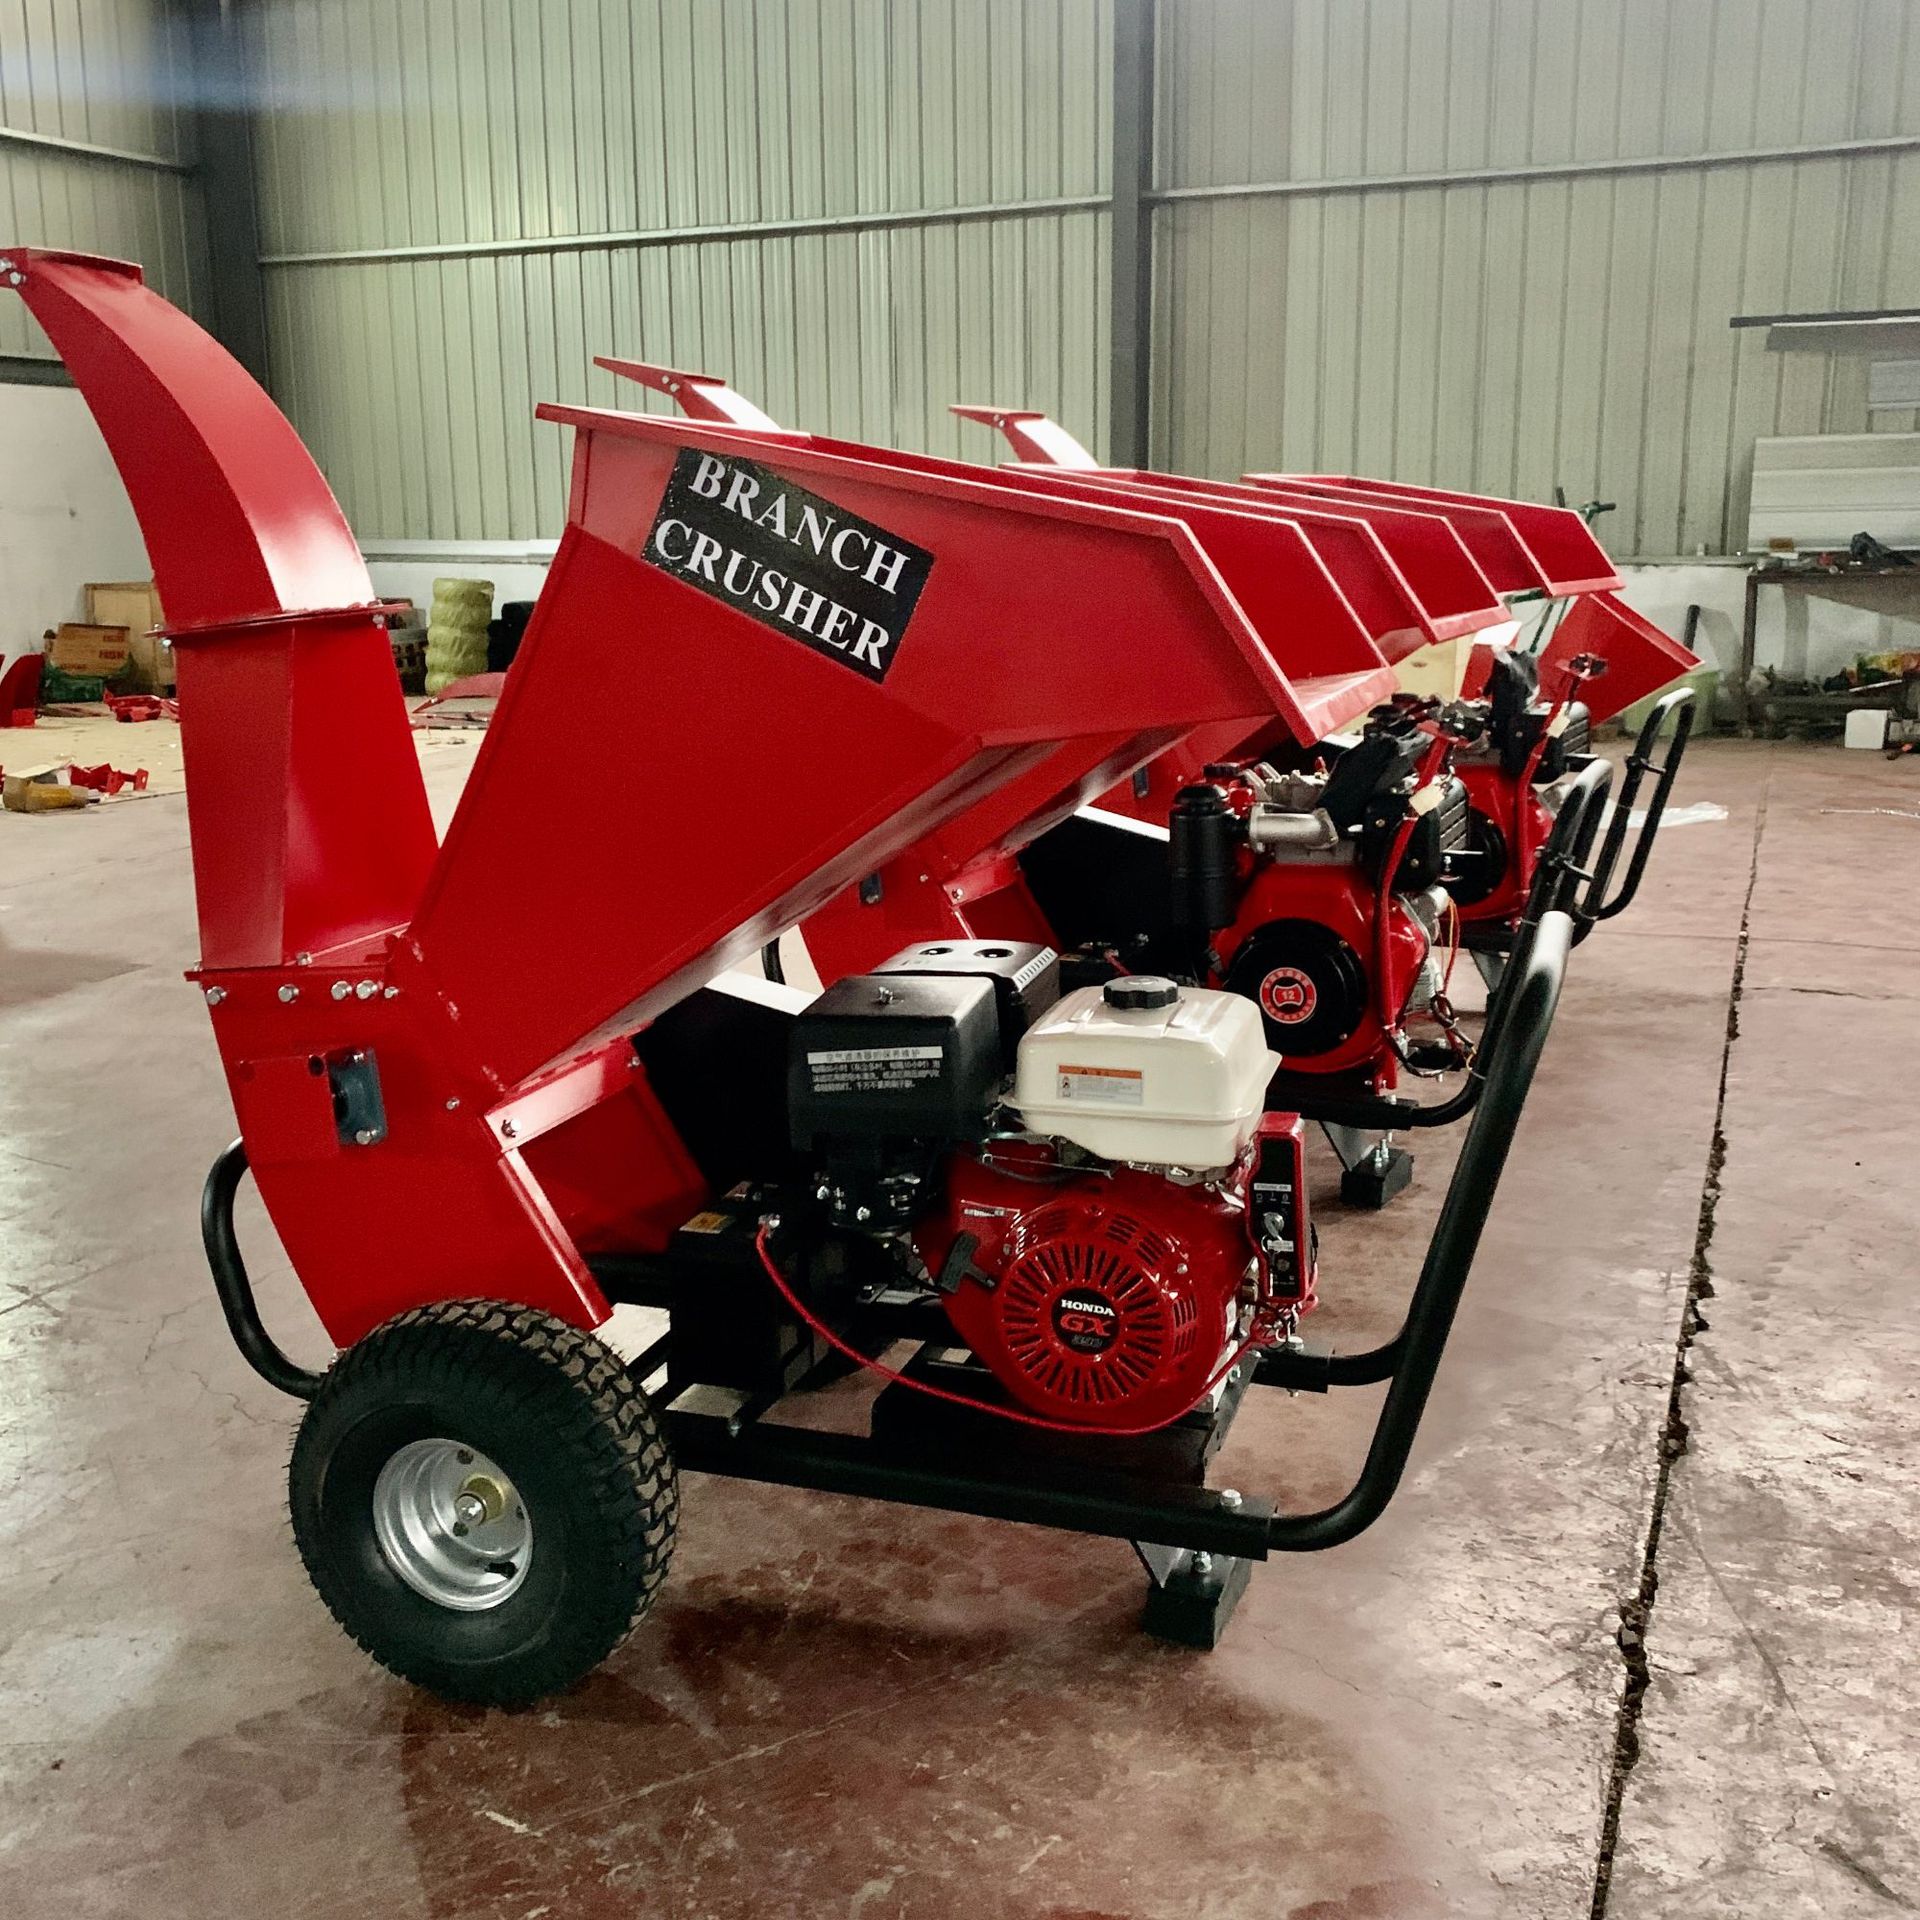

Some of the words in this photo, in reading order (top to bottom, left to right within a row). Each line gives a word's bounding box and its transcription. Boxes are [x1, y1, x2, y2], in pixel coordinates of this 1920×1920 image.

[688, 456, 910, 594] BRANCH
[655, 518, 890, 669] CRUSHER
[1282, 990, 1295, 1000] 12
[1061, 1299, 1115, 1317] HONDA
[1060, 1313, 1111, 1337] GX
